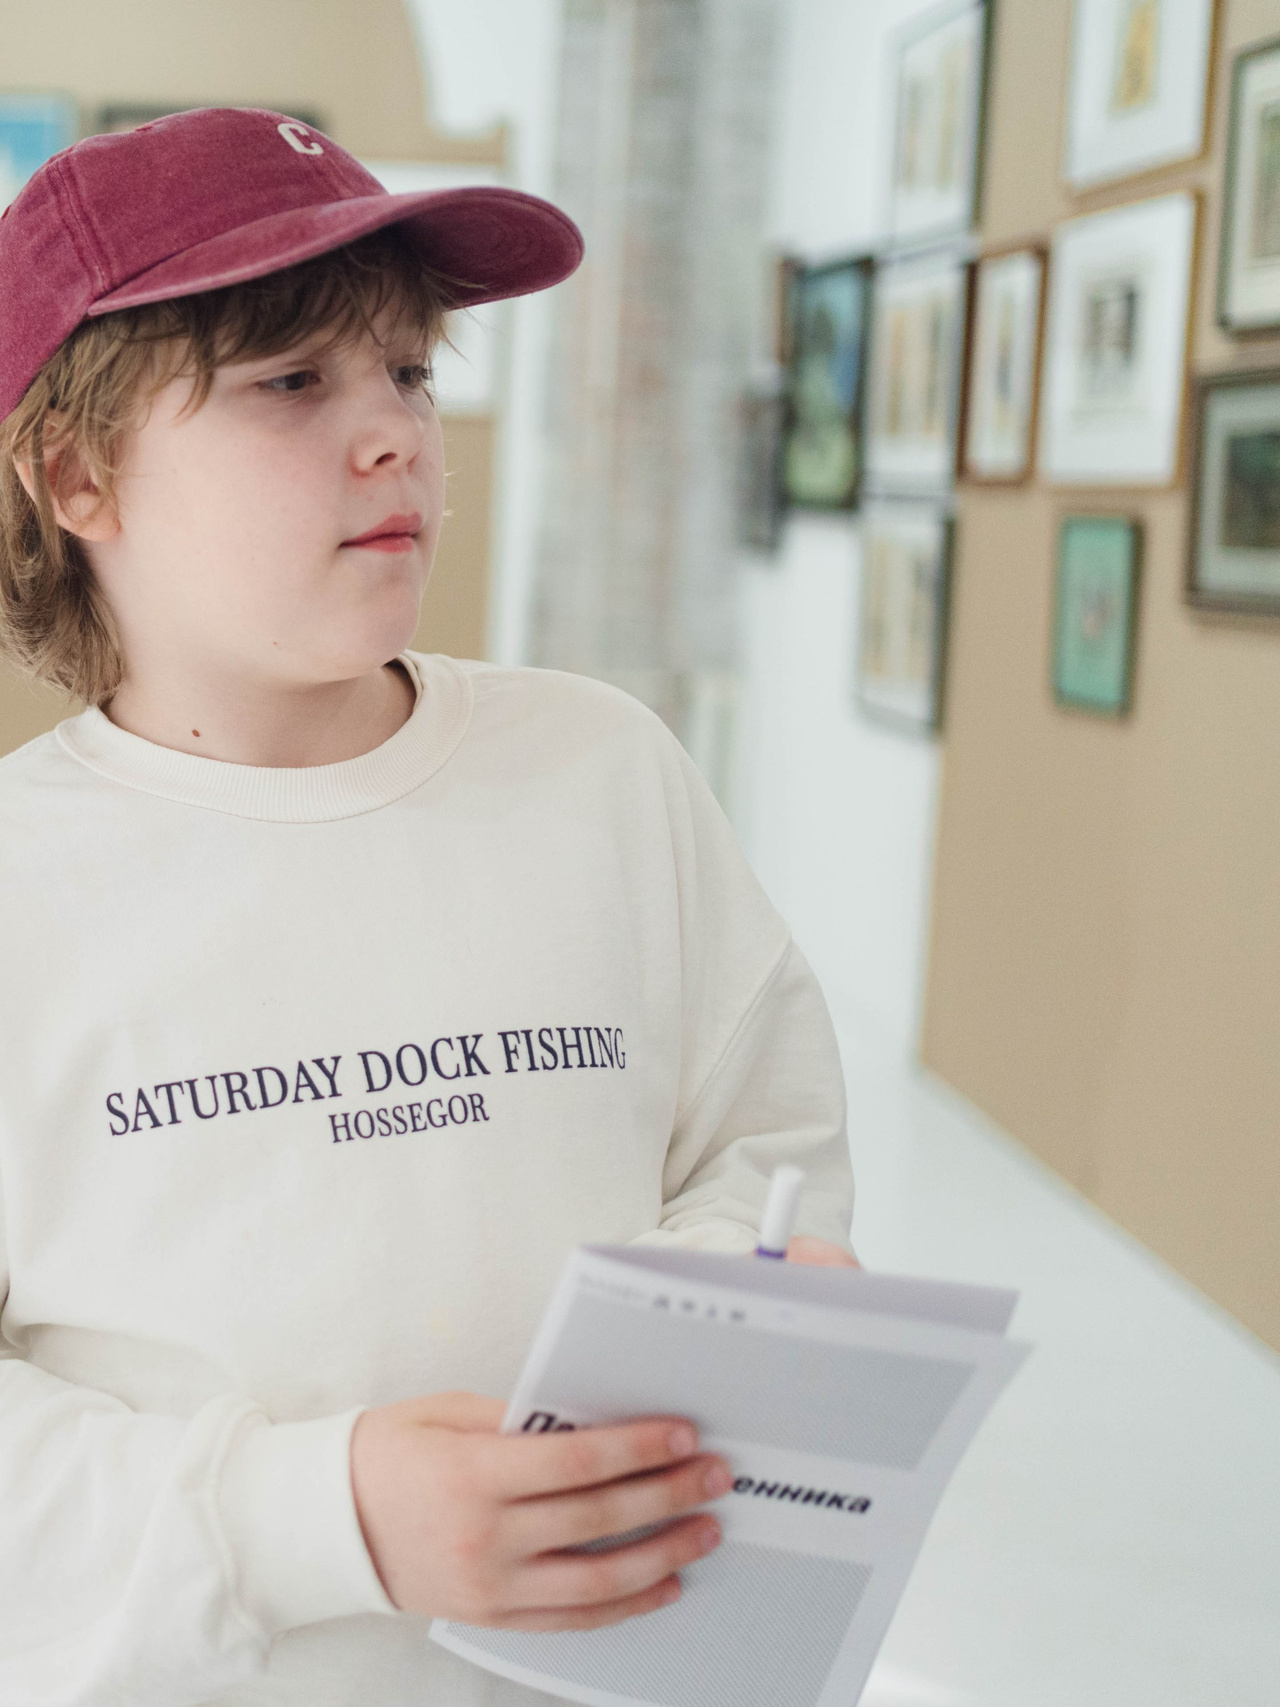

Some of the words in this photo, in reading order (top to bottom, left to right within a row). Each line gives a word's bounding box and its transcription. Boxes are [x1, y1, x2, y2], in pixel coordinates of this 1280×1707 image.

[277, 122, 324, 155] C
[106, 1055, 343, 1136] SATURDAY
[357, 1033, 491, 1093] DOCK
[497, 1027, 626, 1074] FISHING
[328, 1093, 490, 1143] HOSSEGOR
